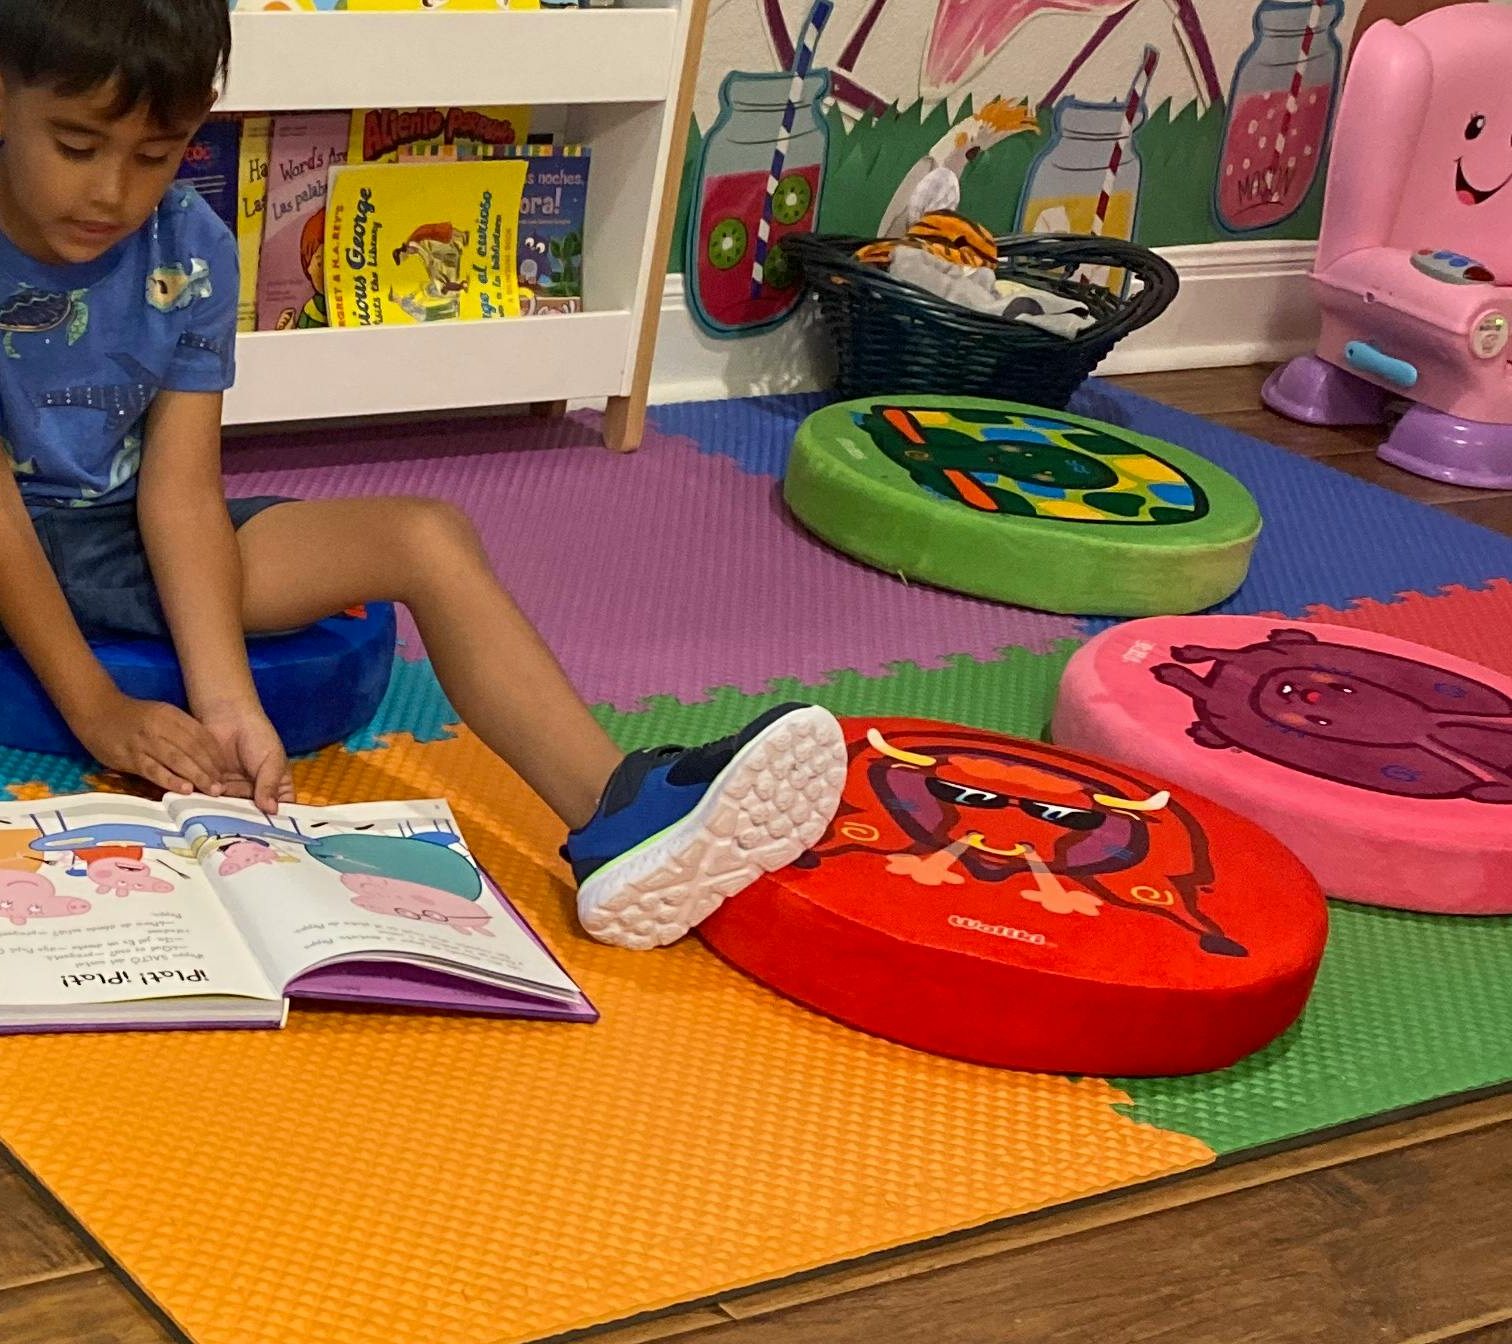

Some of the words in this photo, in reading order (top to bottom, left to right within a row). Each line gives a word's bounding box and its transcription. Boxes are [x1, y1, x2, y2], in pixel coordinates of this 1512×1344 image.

[280, 145, 324, 182] Words
[345, 187, 375, 269] George
[61, 970, 132, 988] ¡Plat!
[139, 968, 210, 986] ¡Plat!
